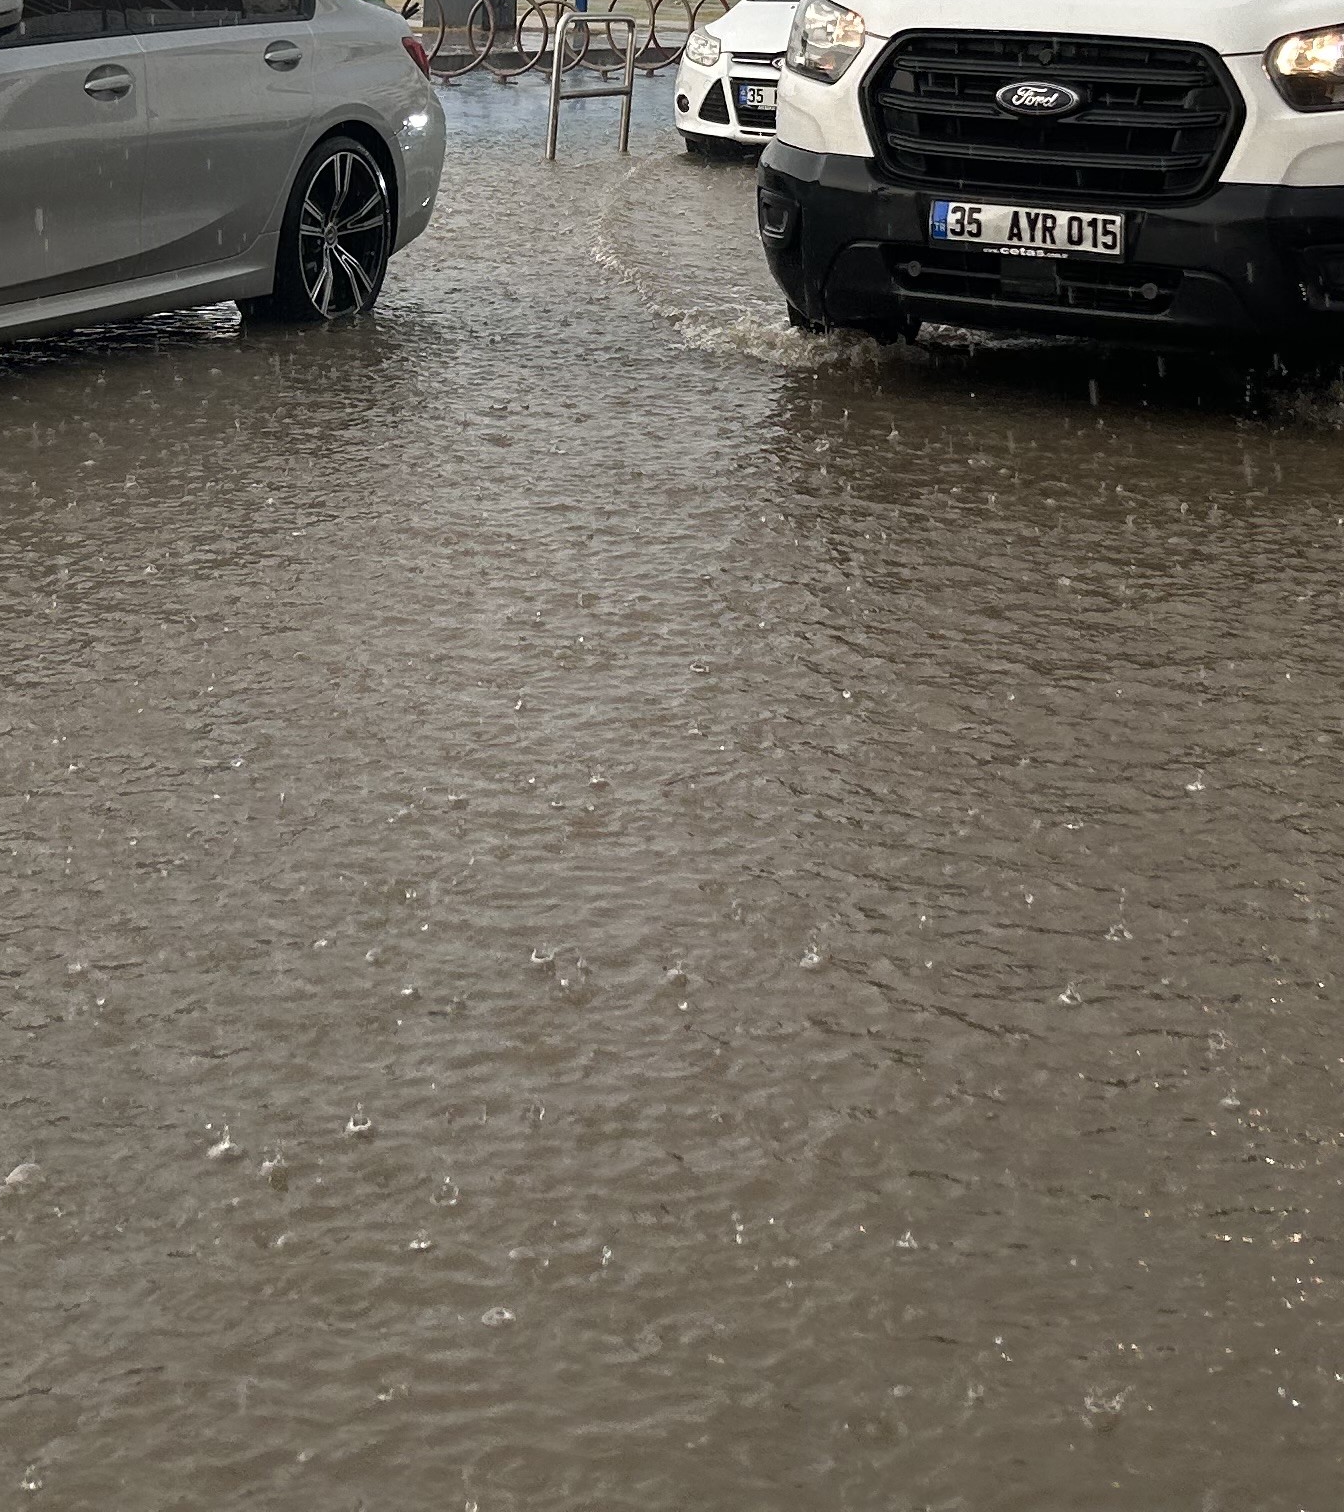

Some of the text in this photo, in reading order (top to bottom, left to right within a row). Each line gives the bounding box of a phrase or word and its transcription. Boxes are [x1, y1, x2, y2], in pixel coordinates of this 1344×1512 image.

[747, 88, 764, 103] 35
[1012, 86, 1059, 107] Ford
[949, 206, 982, 238] 35
[1007, 210, 1057, 245] AYR
[1067, 216, 1118, 250] 015
